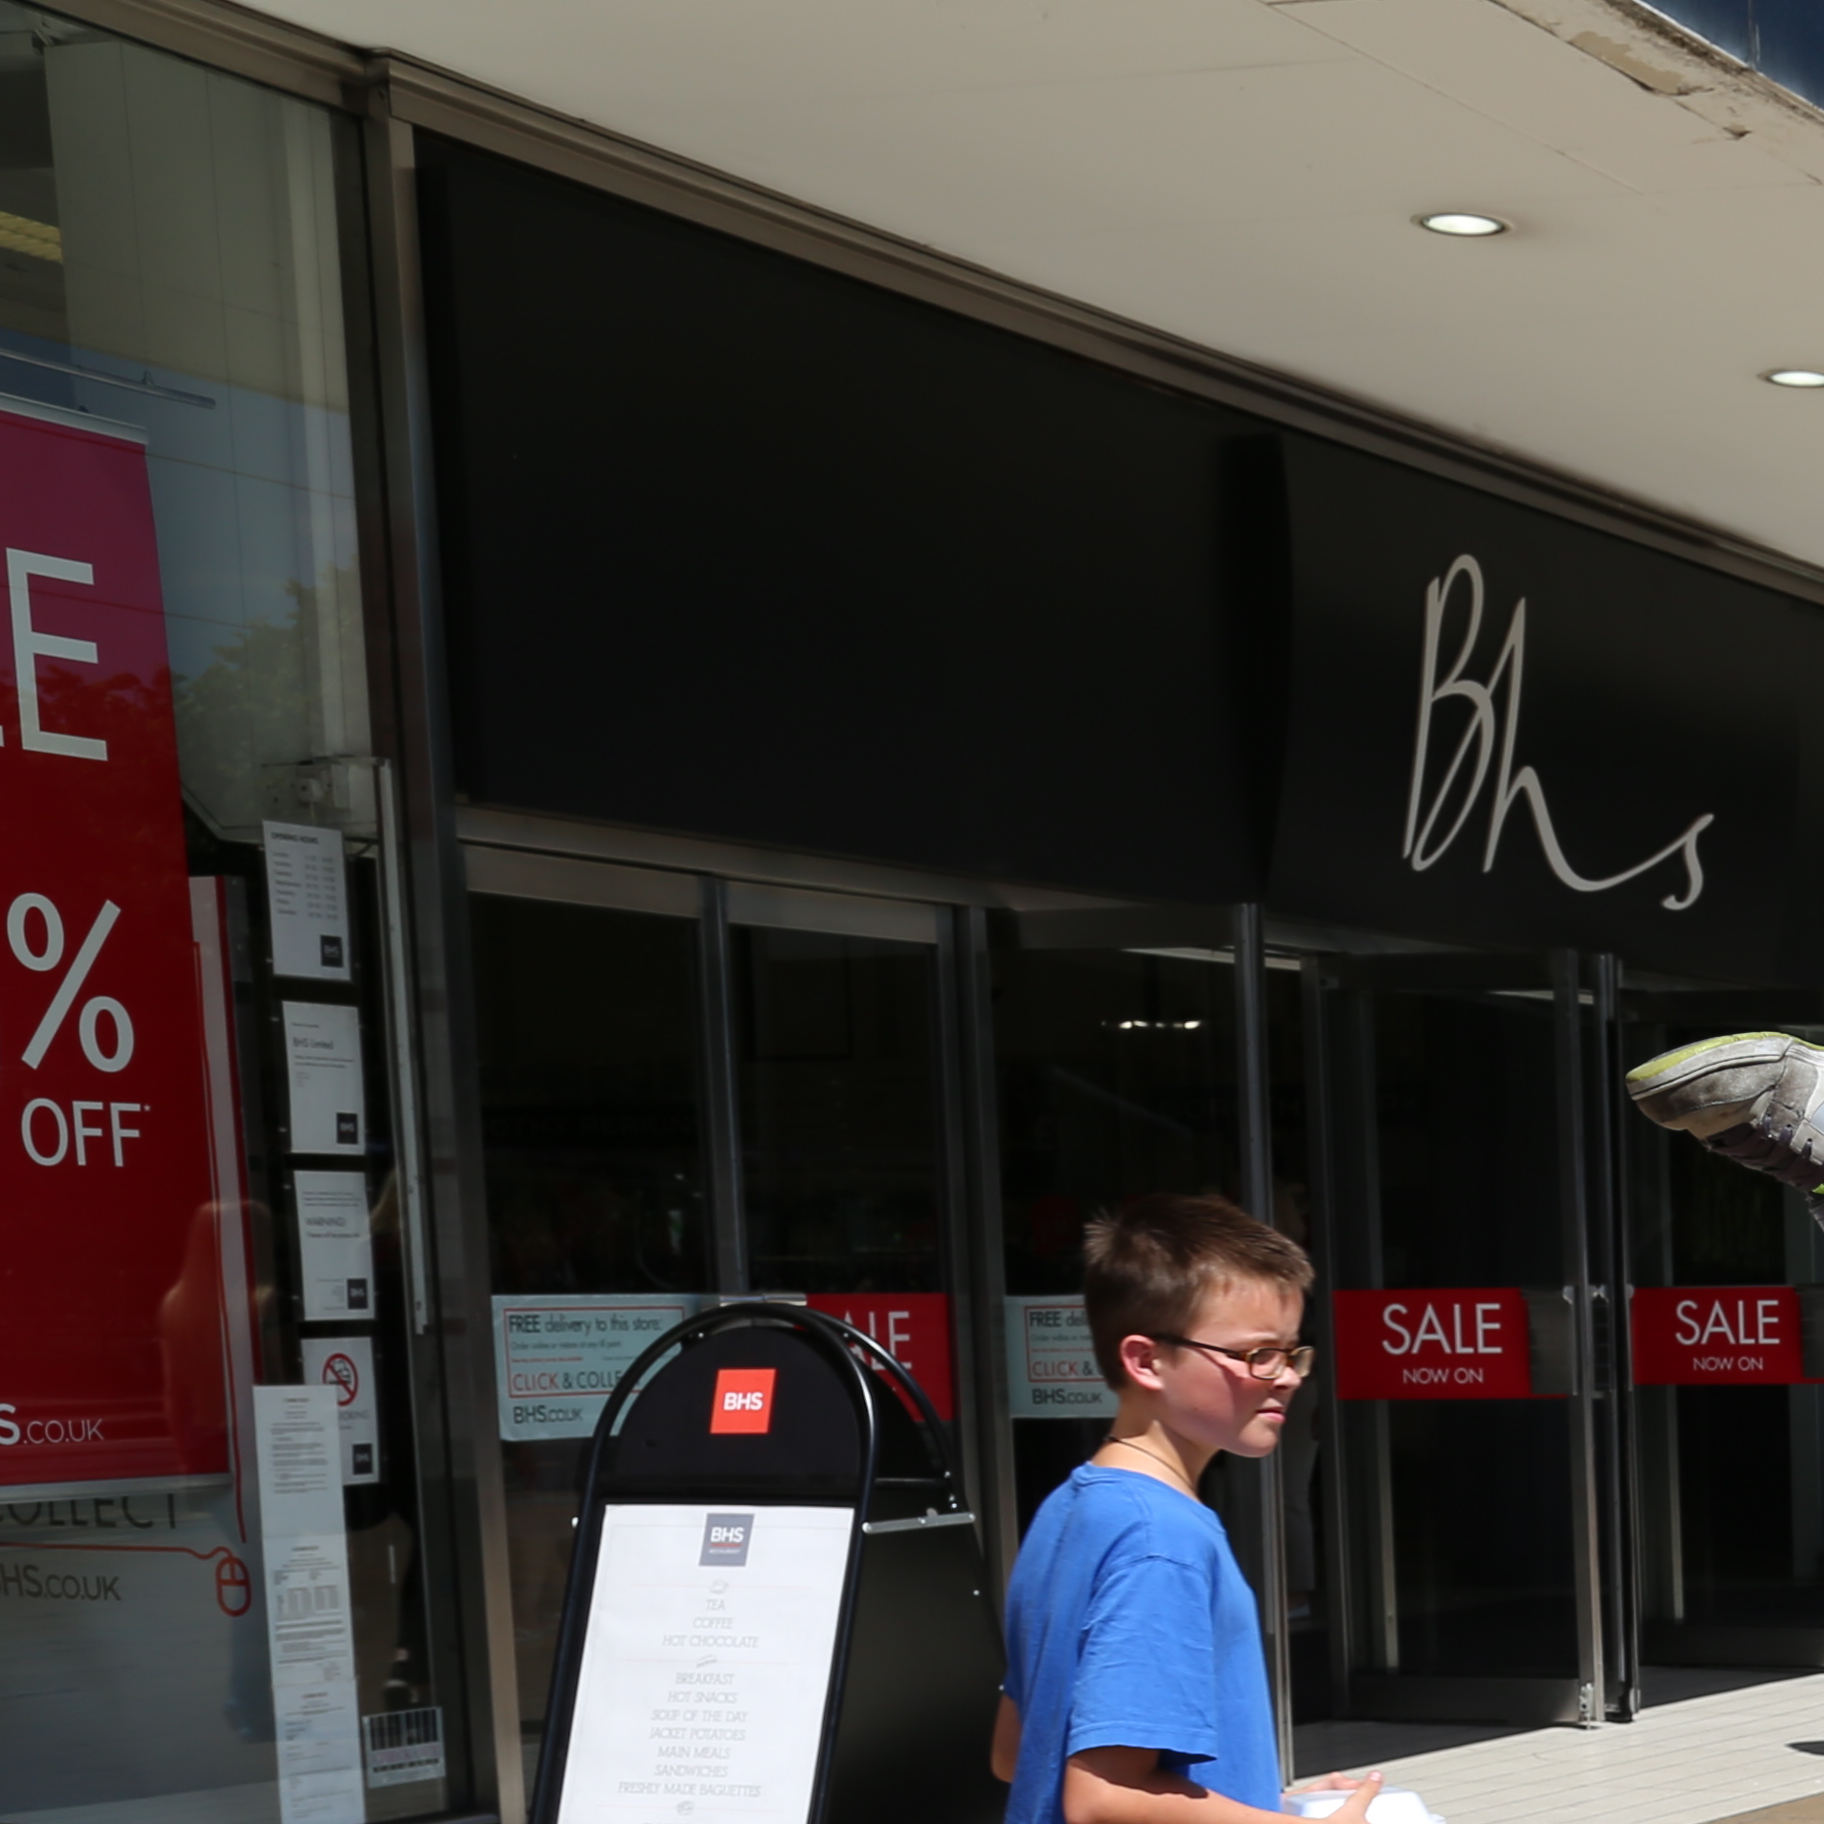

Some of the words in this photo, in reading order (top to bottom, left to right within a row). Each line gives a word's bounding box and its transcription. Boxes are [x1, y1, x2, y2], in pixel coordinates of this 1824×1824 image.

[1402, 553, 1715, 912] Bhs
[509, 1313, 541, 1333] FREE
[545, 1312, 591, 1336] delivery
[595, 1316, 607, 1332] to
[611, 1314, 629, 1332] this
[1029, 1311, 1062, 1328] FREE
[1675, 1299, 1782, 1346] SALE
[1382, 1303, 1503, 1356] SALE
[1032, 1360, 1079, 1377] CLICK
[1082, 1361, 1093, 1377] &
[1693, 1356, 1734, 1372] NOW
[1737, 1356, 1764, 1372] ON
[512, 1372, 559, 1391] CLICK
[562, 1372, 573, 1389] &
[1402, 1368, 1449, 1385] NOW
[1454, 1367, 1484, 1384] ON
[723, 1392, 764, 1411] BHS
[711, 1527, 745, 1543] BHS
[705, 1599, 725, 1611] TEA
[692, 1617, 733, 1629] COFFEE
[662, 1635, 686, 1647] HOT
[689, 1636, 758, 1648] CHOCOLATE
[675, 1672, 735, 1685] BREAKFAST
[667, 1691, 692, 1703] HOT
[694, 1692, 738, 1704] SNACKS
[651, 1709, 681, 1721] SOUP
[683, 1710, 699, 1721] OF
[702, 1710, 724, 1722] THE
[725, 1711, 749, 1723] DAY
[649, 1727, 687, 1739] JACKET
[689, 1728, 746, 1741] POTATOES
[657, 1746, 691, 1758] MAIN
[693, 1747, 731, 1759] MEALS
[654, 1764, 729, 1777] SANDWICHES
[617, 1781, 661, 1794] FRESHLY
[663, 1783, 697, 1795] MADE
[698, 1784, 762, 1797] BAGUETTES
